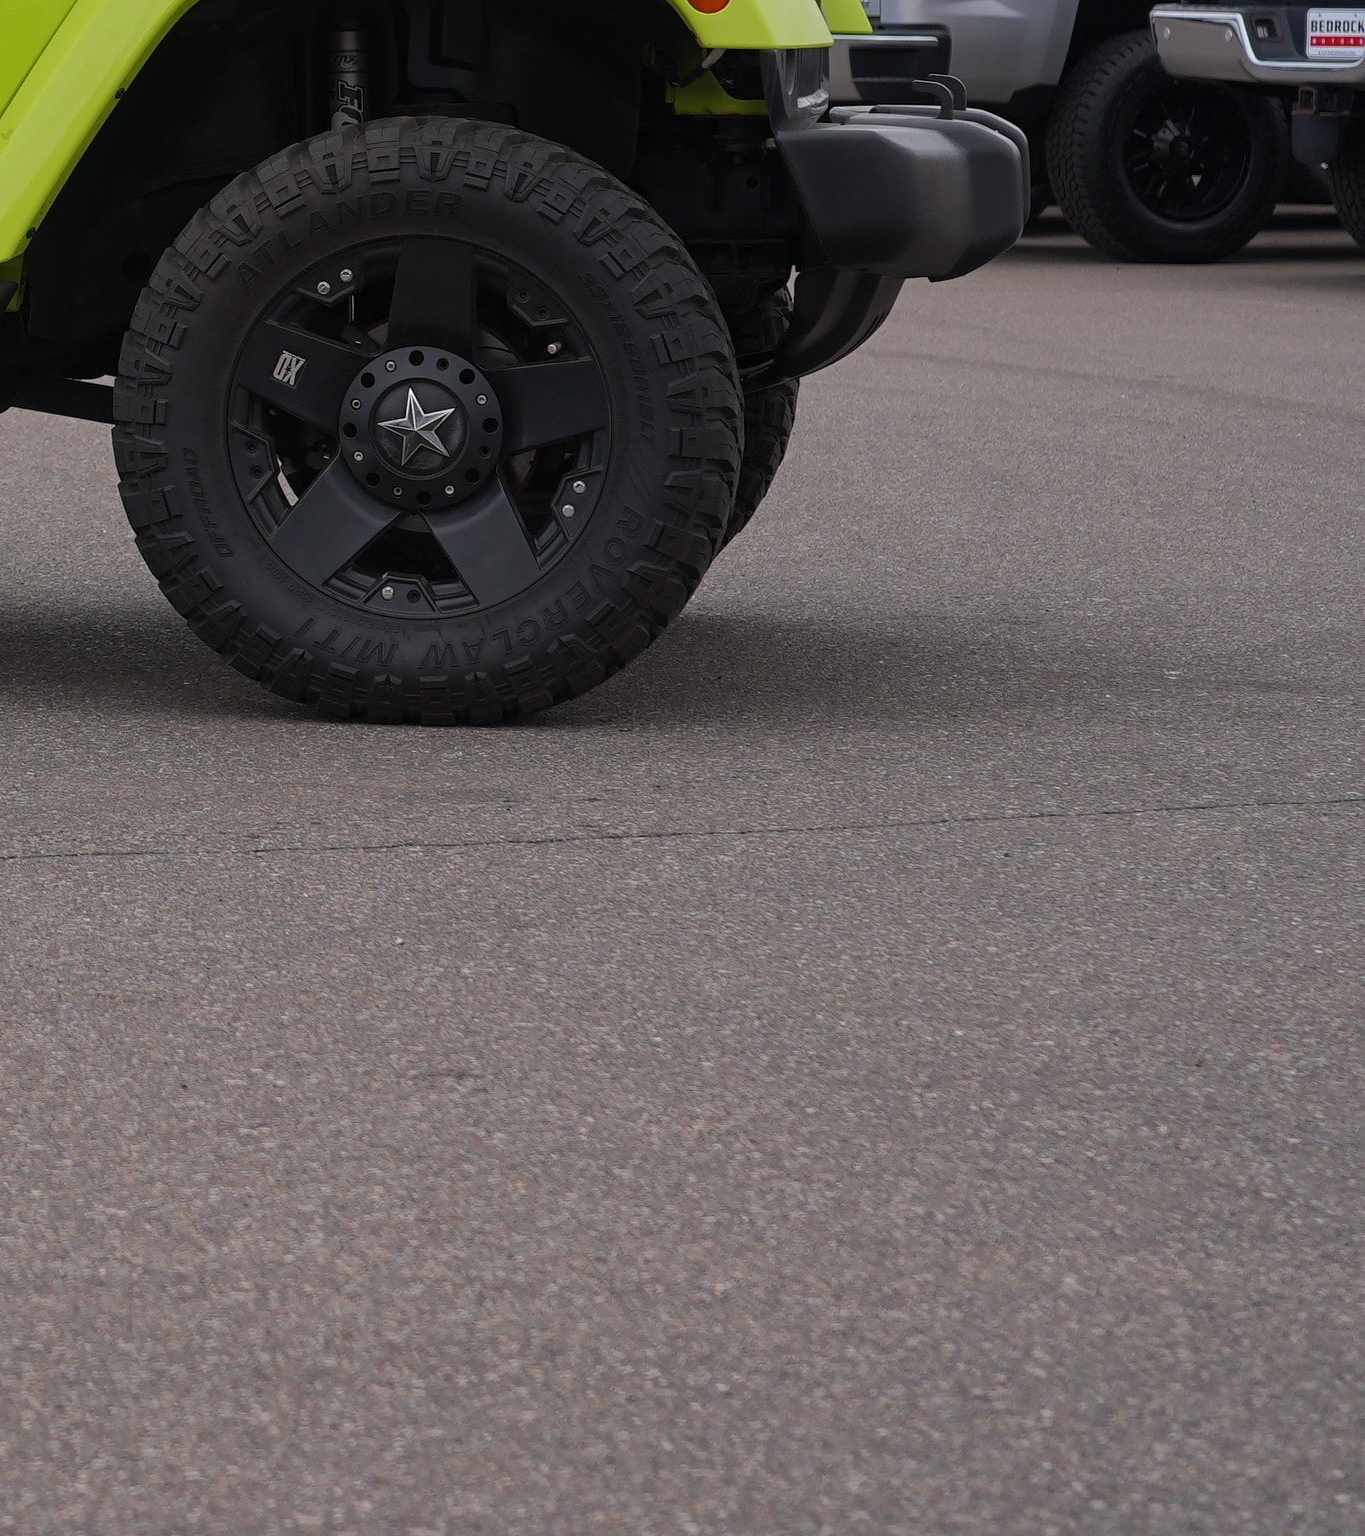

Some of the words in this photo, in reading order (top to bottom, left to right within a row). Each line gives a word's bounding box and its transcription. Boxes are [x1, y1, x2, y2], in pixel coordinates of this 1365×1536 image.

[1310, 20, 1364, 33] BEDROCK
[236, 189, 465, 293] ATLANDER
[416, 504, 646, 670] ROVERCLAW
